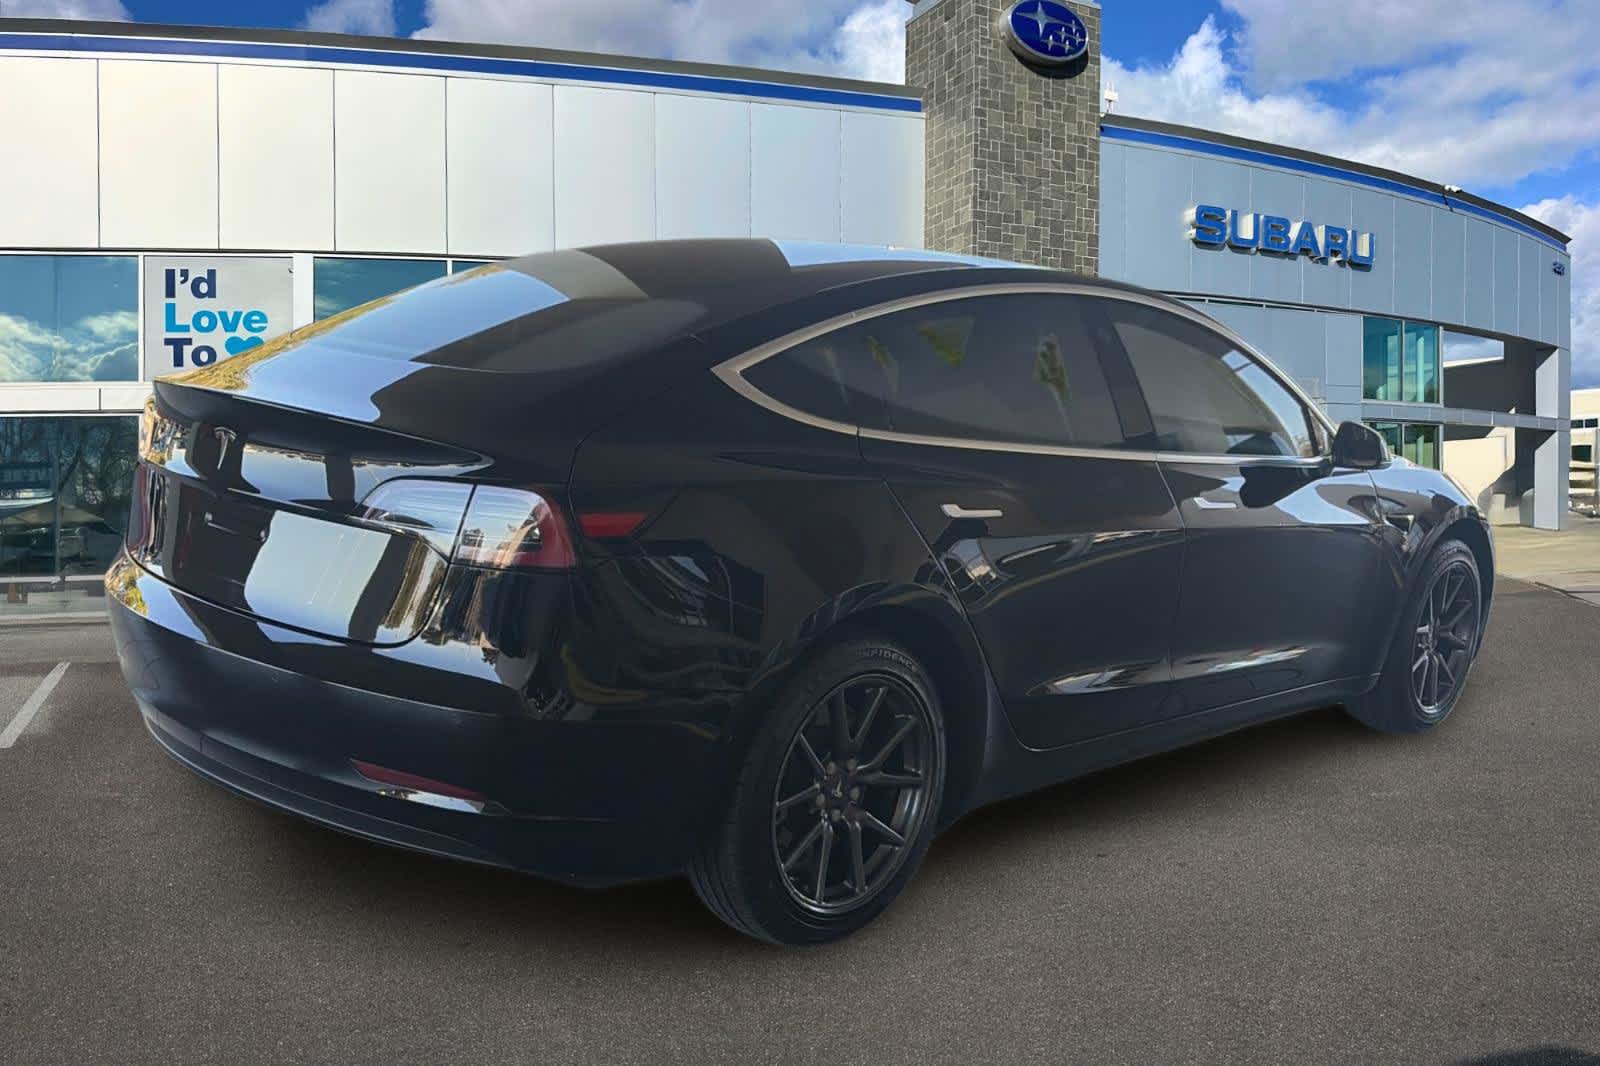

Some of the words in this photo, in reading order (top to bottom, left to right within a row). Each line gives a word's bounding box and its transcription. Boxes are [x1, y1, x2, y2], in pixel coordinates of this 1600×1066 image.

[1194, 204, 1375, 268] SUBARU
[165, 268, 217, 299] I’d
[164, 302, 269, 333] Love
[163, 337, 217, 368] To
